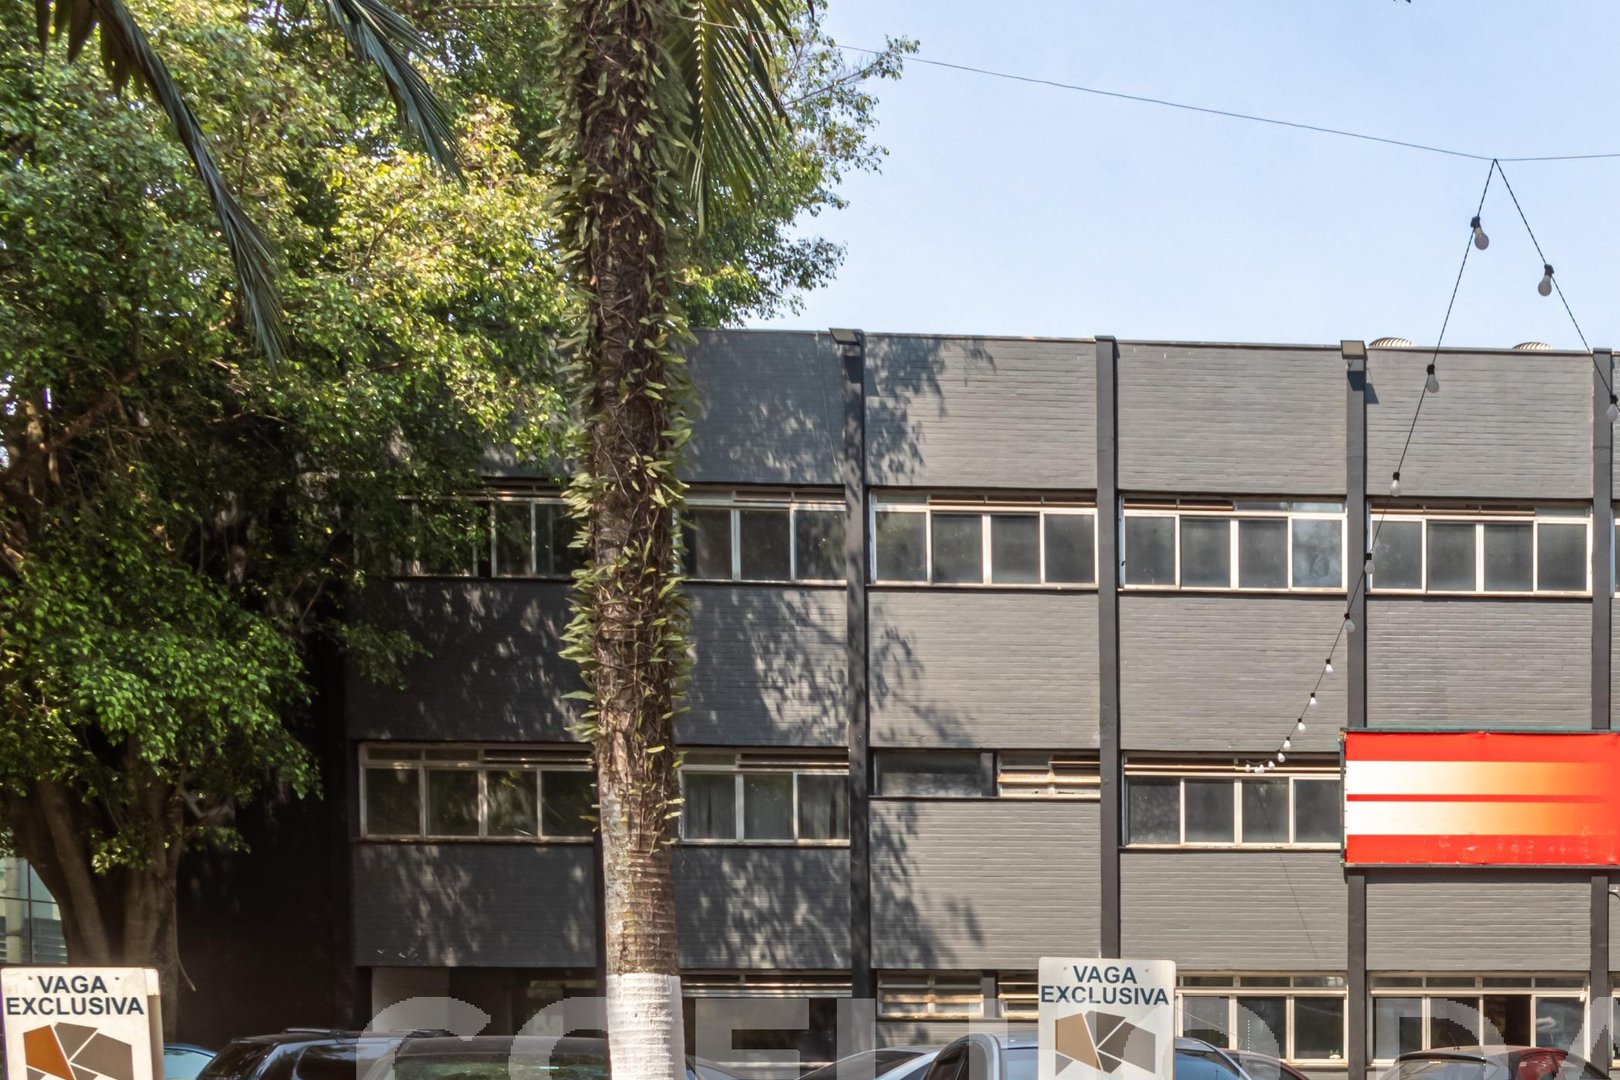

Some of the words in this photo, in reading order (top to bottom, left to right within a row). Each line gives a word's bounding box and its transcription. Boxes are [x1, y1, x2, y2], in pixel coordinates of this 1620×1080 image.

[1073, 965, 1137, 984] VAGA
[37, 976, 108, 994] VAGA
[1041, 985, 1169, 1005] EXCLUSIVA
[6, 997, 145, 1015] EXCLUSIVA
